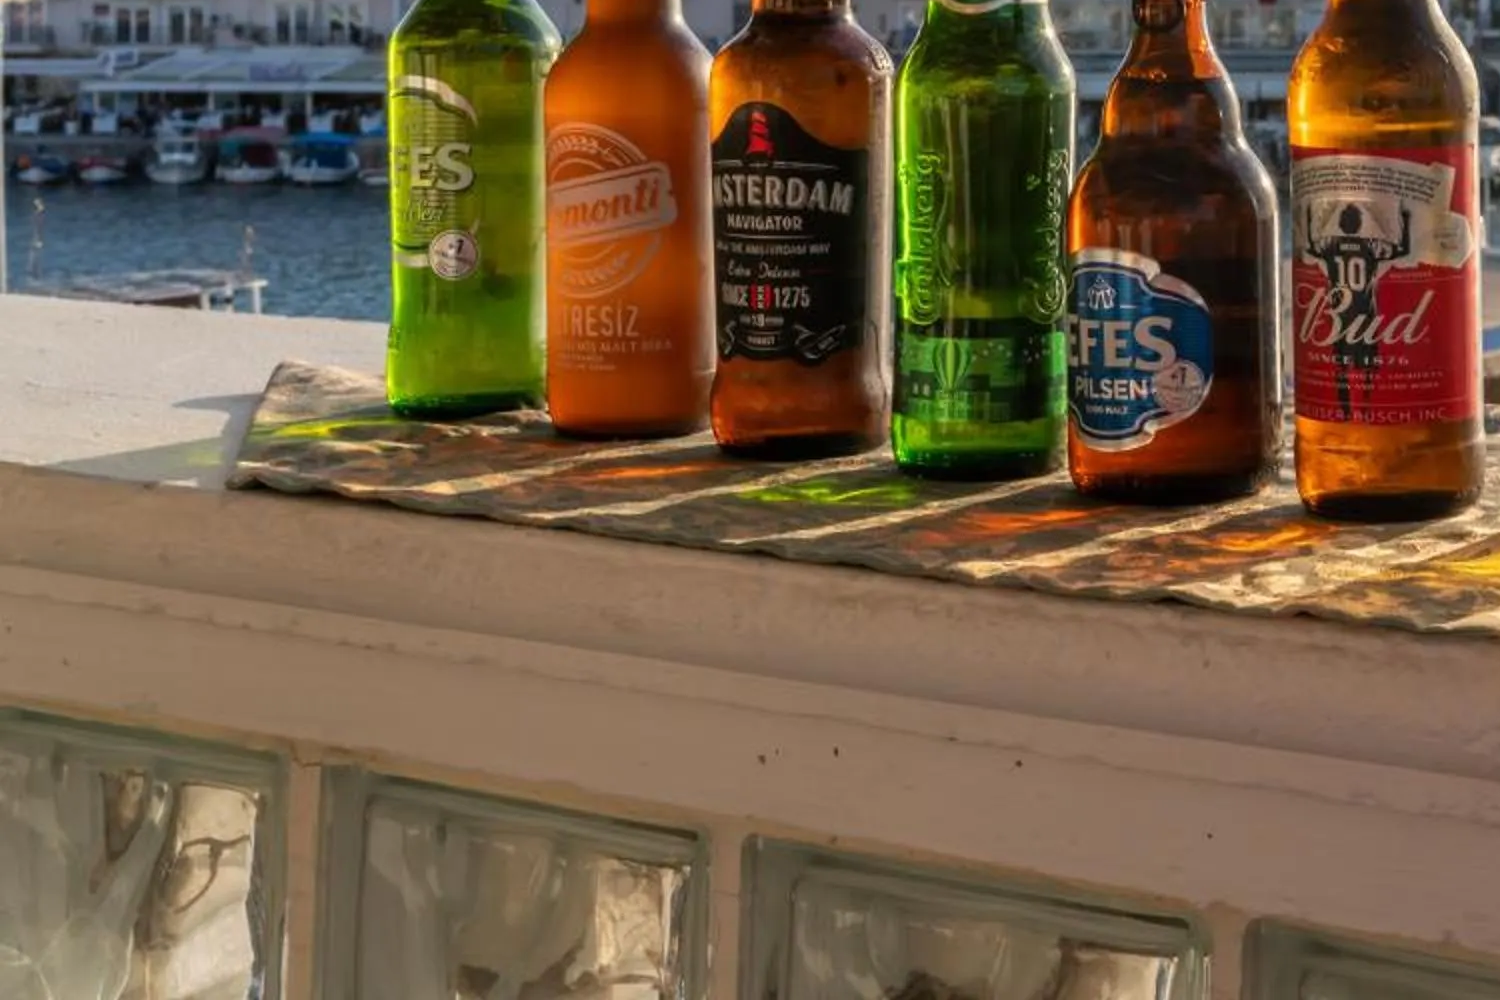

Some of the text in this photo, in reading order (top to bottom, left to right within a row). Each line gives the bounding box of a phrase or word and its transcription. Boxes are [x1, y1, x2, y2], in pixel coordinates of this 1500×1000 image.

[563, 178, 661, 229] monti
[727, 213, 803, 231] NAVIGATOR
[1335, 256, 1367, 292] 10
[774, 286, 811, 308] 1275
[1296, 283, 1434, 347] Bud
[1066, 314, 1176, 371] EFES
[1308, 351, 1411, 367] SINCE 1876
